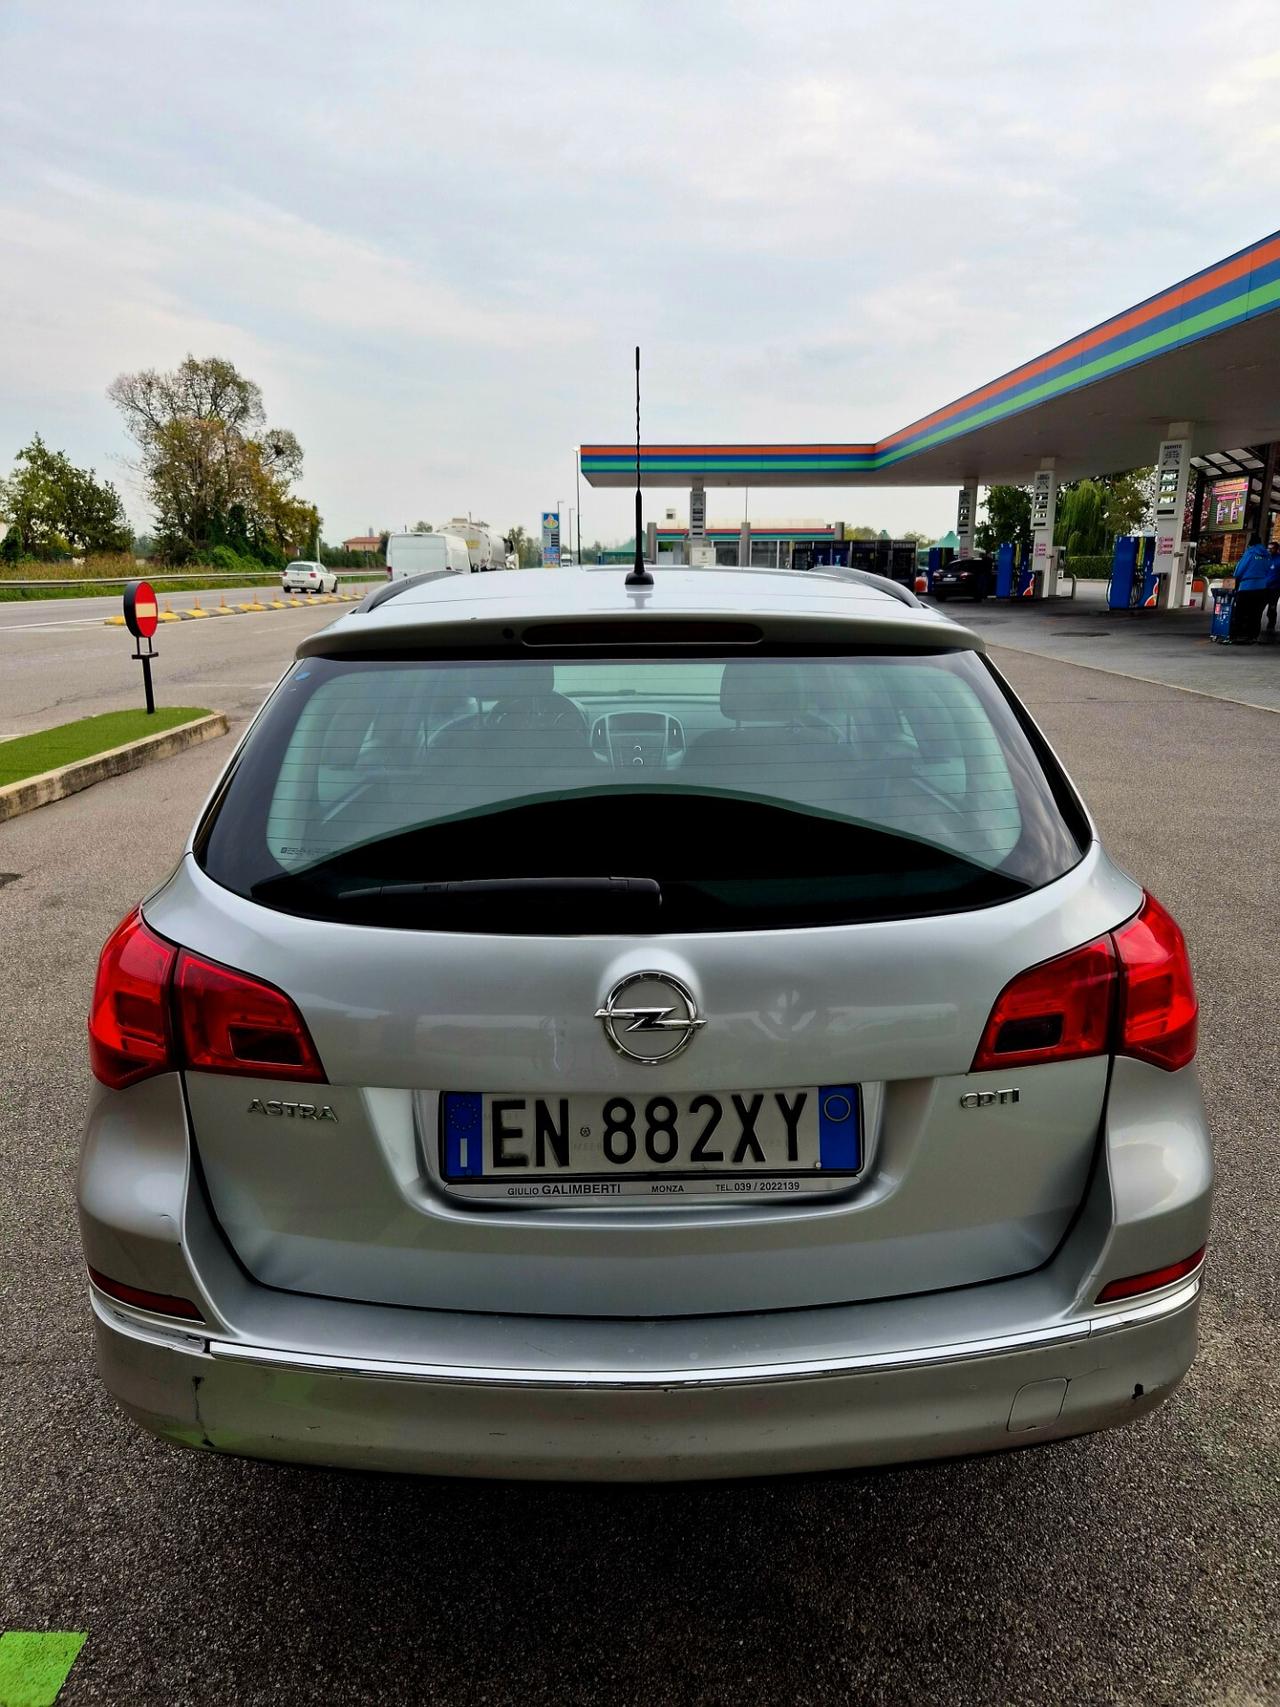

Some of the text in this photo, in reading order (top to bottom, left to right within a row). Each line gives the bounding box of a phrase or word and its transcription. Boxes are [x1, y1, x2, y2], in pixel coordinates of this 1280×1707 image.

[960, 1088, 1020, 1108] CDTI
[247, 1098, 339, 1123] ASTRA
[491, 1092, 808, 1168] EN 882XY
[507, 1187, 540, 1197] GIULIO
[541, 1184, 621, 1195] GALIMBERTI
[651, 1184, 685, 1193] MONZA
[759, 1181, 800, 1191] 2022139
